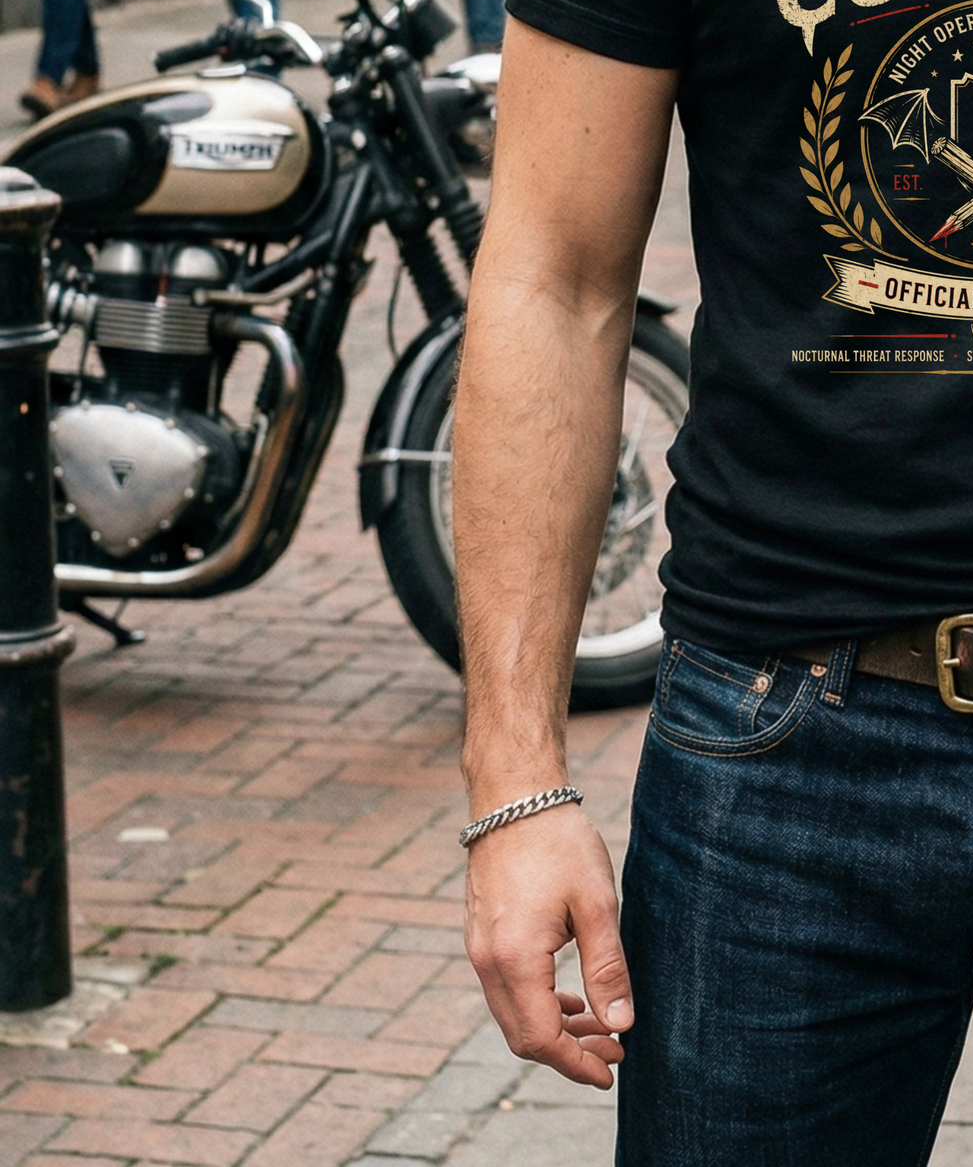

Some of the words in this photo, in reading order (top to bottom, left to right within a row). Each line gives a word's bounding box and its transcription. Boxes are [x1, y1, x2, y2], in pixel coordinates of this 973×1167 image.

[888, 35, 933, 85] NIGHT
[893, 174, 923, 191] EST.
[791, 350, 850, 362] NOCTURNAL
[853, 350, 891, 362] THREAT
[894, 350, 945, 362] RESPONSE
